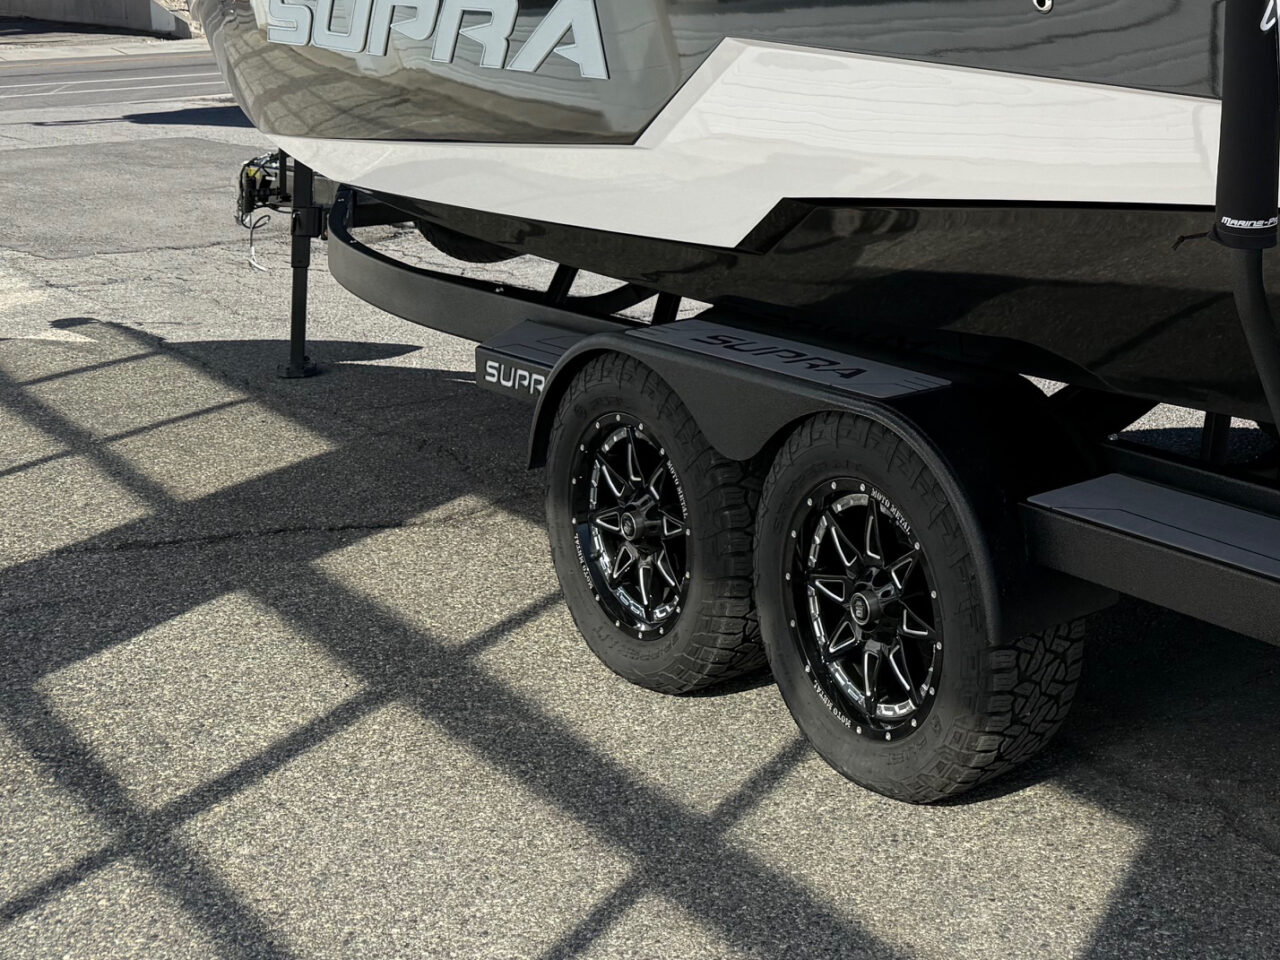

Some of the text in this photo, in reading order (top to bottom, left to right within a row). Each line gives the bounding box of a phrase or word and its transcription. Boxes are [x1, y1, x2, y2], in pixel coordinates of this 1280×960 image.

[692, 334, 868, 380] SUPRA
[484, 360, 546, 395] SUPR
[871, 487, 891, 508] MOTO
